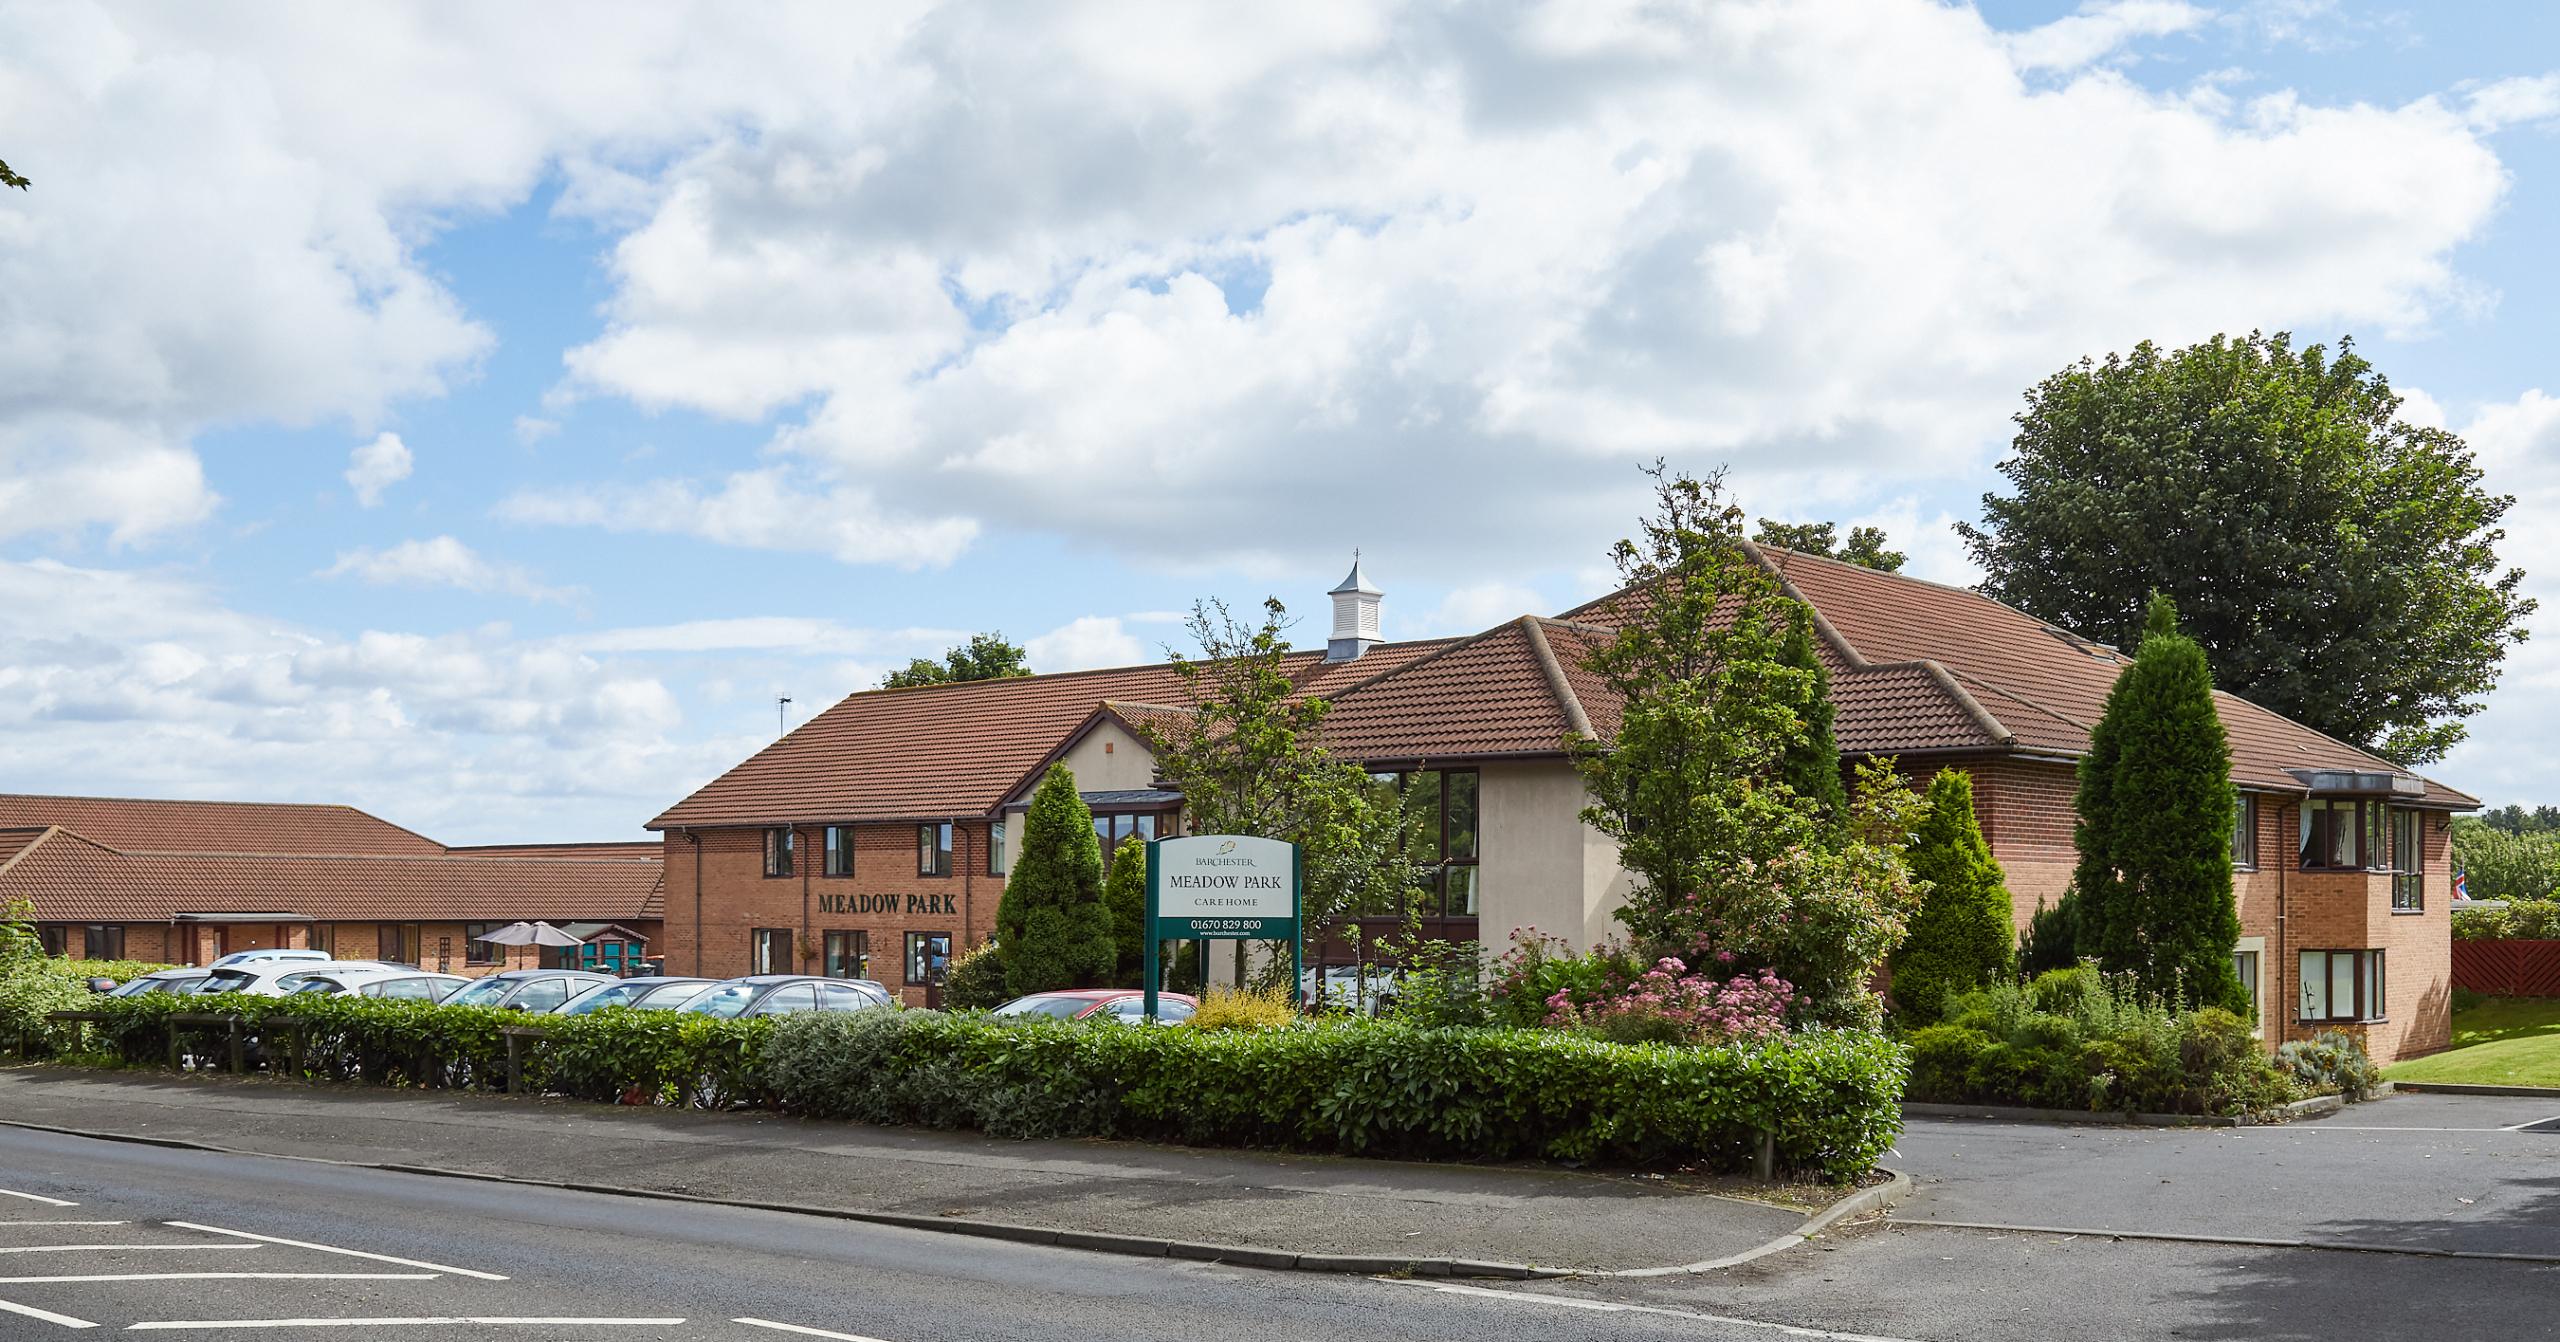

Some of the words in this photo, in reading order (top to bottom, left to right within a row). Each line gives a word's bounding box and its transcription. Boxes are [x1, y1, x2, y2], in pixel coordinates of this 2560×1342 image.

[1195, 857, 1257, 867] BARCHESTER
[1170, 875, 1239, 889] MEADOW
[1244, 876, 1282, 889] PARK
[818, 893, 900, 914] MEADOW
[906, 894, 957, 914] PARK
[1194, 898, 1224, 906] CARE
[1226, 898, 1259, 907] HOME
[1191, 920, 1221, 930] 01670
[1222, 920, 1241, 930] 829
[1243, 920, 1262, 930] 800
